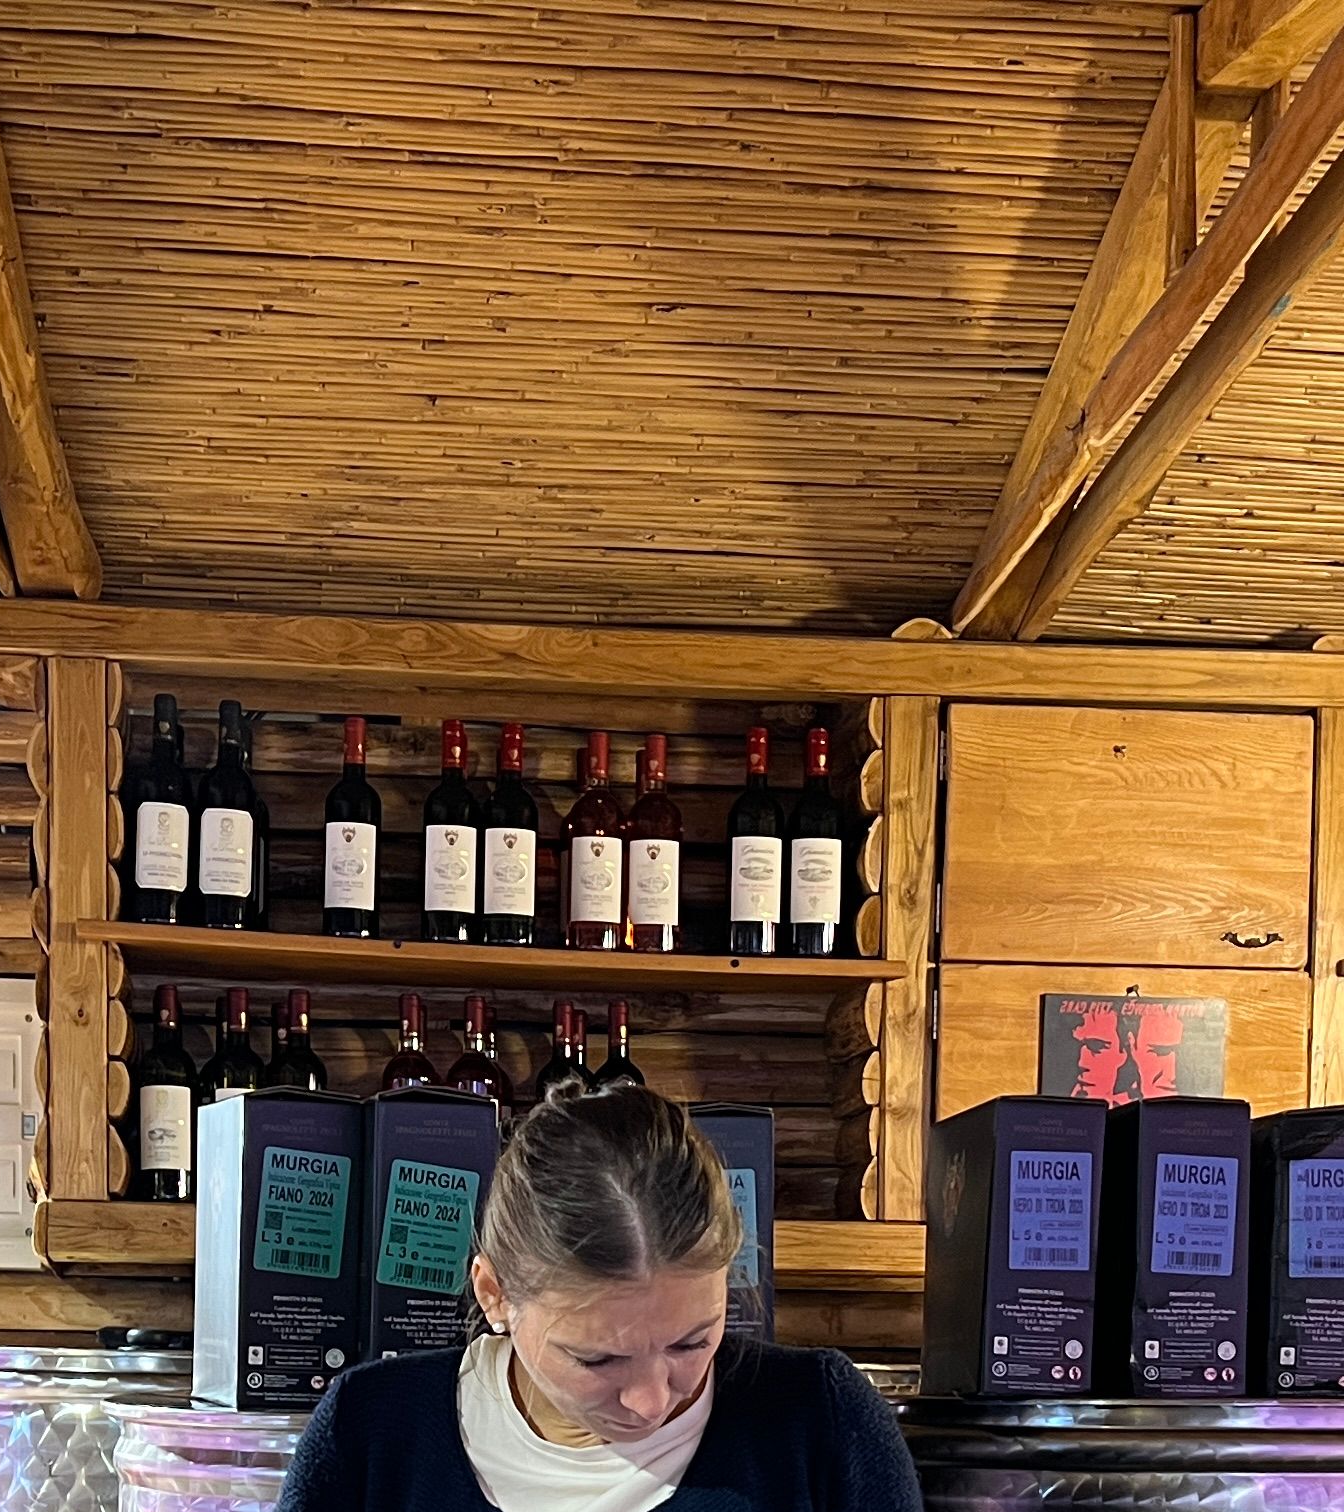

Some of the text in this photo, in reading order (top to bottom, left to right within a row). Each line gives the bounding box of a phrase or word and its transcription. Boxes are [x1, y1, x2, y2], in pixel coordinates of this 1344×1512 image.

[271, 1153, 340, 1176] MURGIA
[1018, 1160, 1081, 1181] MURGIA
[1163, 1163, 1226, 1185] MURGIA
[398, 1166, 467, 1191] MURGIA
[269, 1185, 334, 1208] FIANO 2024
[394, 1199, 460, 1224] FIANO 2024
[261, 1230, 283, 1245] L 3
[386, 1244, 407, 1259] L 3
